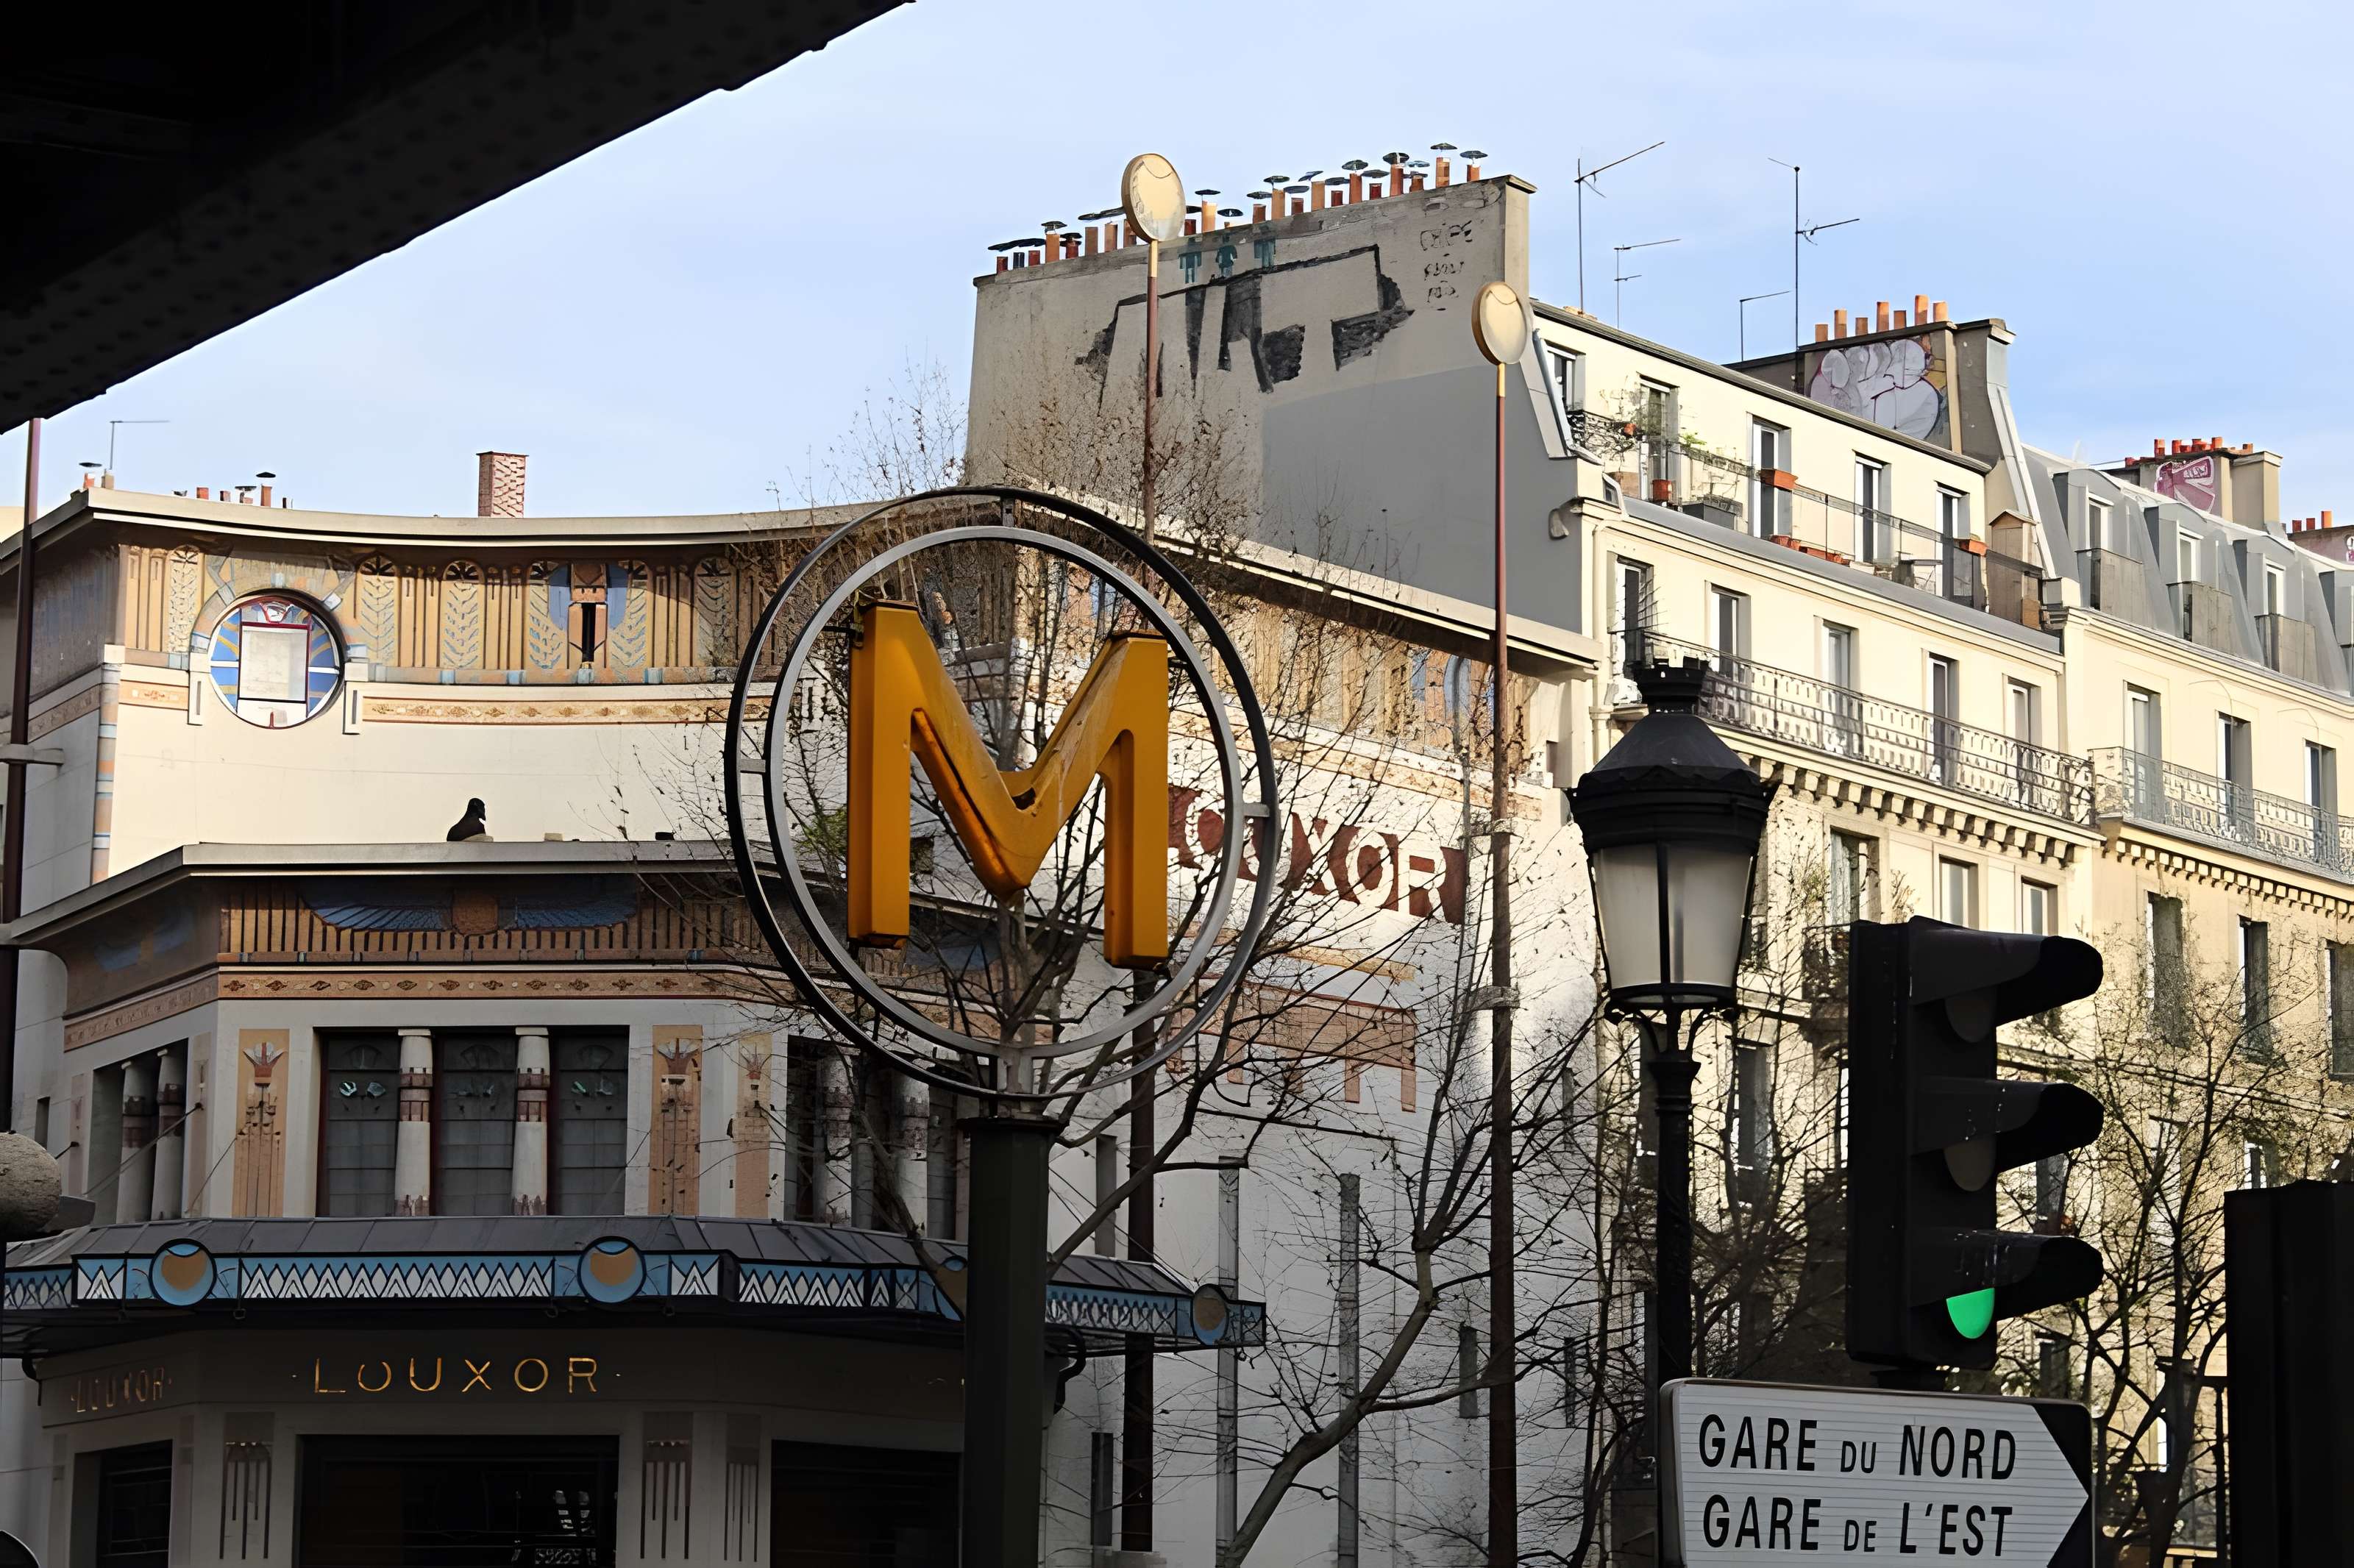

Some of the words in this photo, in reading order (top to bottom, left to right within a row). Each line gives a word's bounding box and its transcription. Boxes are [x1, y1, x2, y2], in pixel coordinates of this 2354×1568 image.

[847, 599, 1170, 971] M
[314, 1357, 598, 1394] LOUXOR
[1699, 1414, 1818, 1471] GARE
[1841, 1440, 1877, 1474] DU
[1899, 1425, 2016, 1480] NORD
[1703, 1494, 1821, 1551] GARE
[1844, 1519, 1877, 1553] DE
[1899, 1502, 2013, 1556] L'EST
